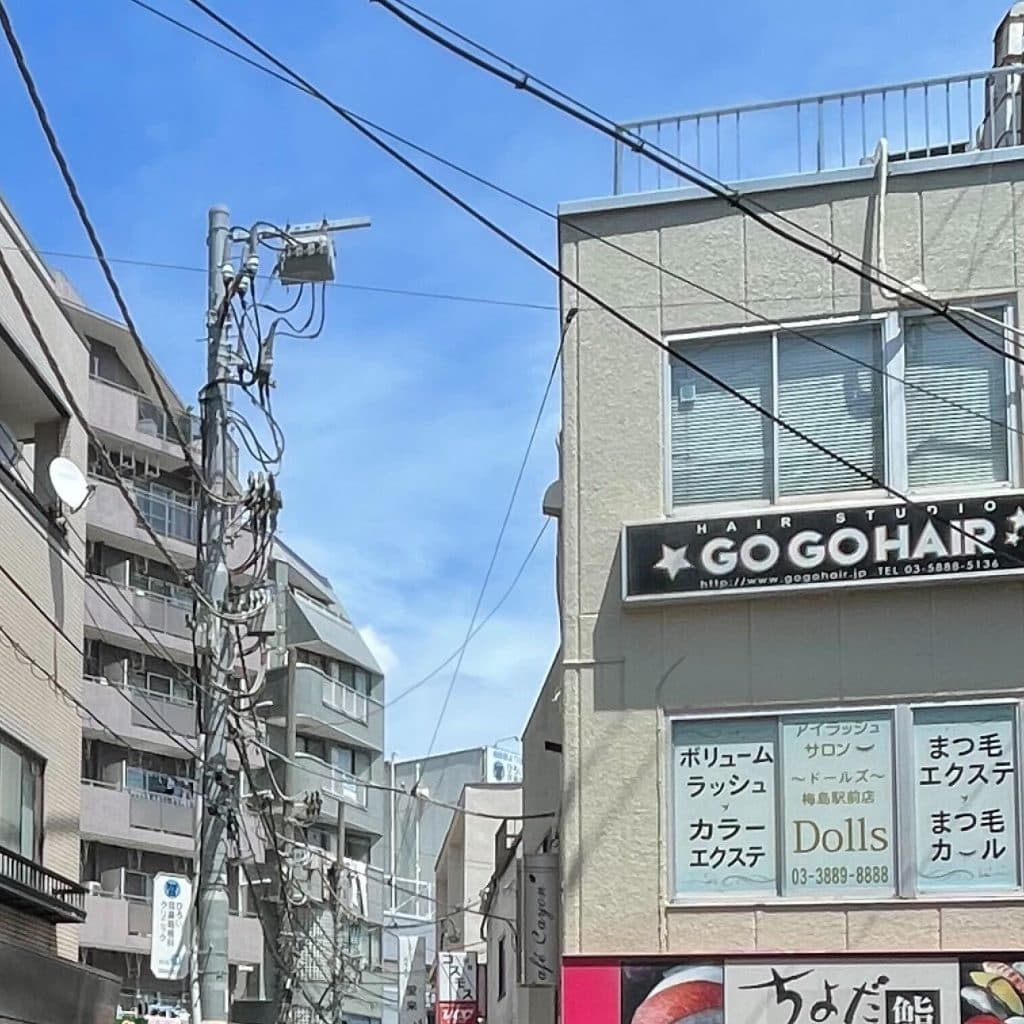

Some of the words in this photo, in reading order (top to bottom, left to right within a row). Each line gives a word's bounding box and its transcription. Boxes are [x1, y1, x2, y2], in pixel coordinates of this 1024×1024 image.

[696, 516, 791, 535] HAIR
[836, 499, 997, 524] STUDIO
[878, 566, 898, 576] TEL
[679, 745, 775, 769] ボリューム
[928, 732, 1004, 760] まつ毛
[686, 773, 768, 798] ラッシュ
[919, 760, 1015, 787] エクステ
[801, 790, 876, 806] 梅島駅前店
[689, 817, 766, 842] カラー
[930, 808, 1006, 834] まつ毛
[792, 817, 889, 854] Dolls
[689, 846, 766, 869] エクステ
[791, 865, 889, 885] 03-3889-8888
[442, 954, 473, 1000] コスモス
